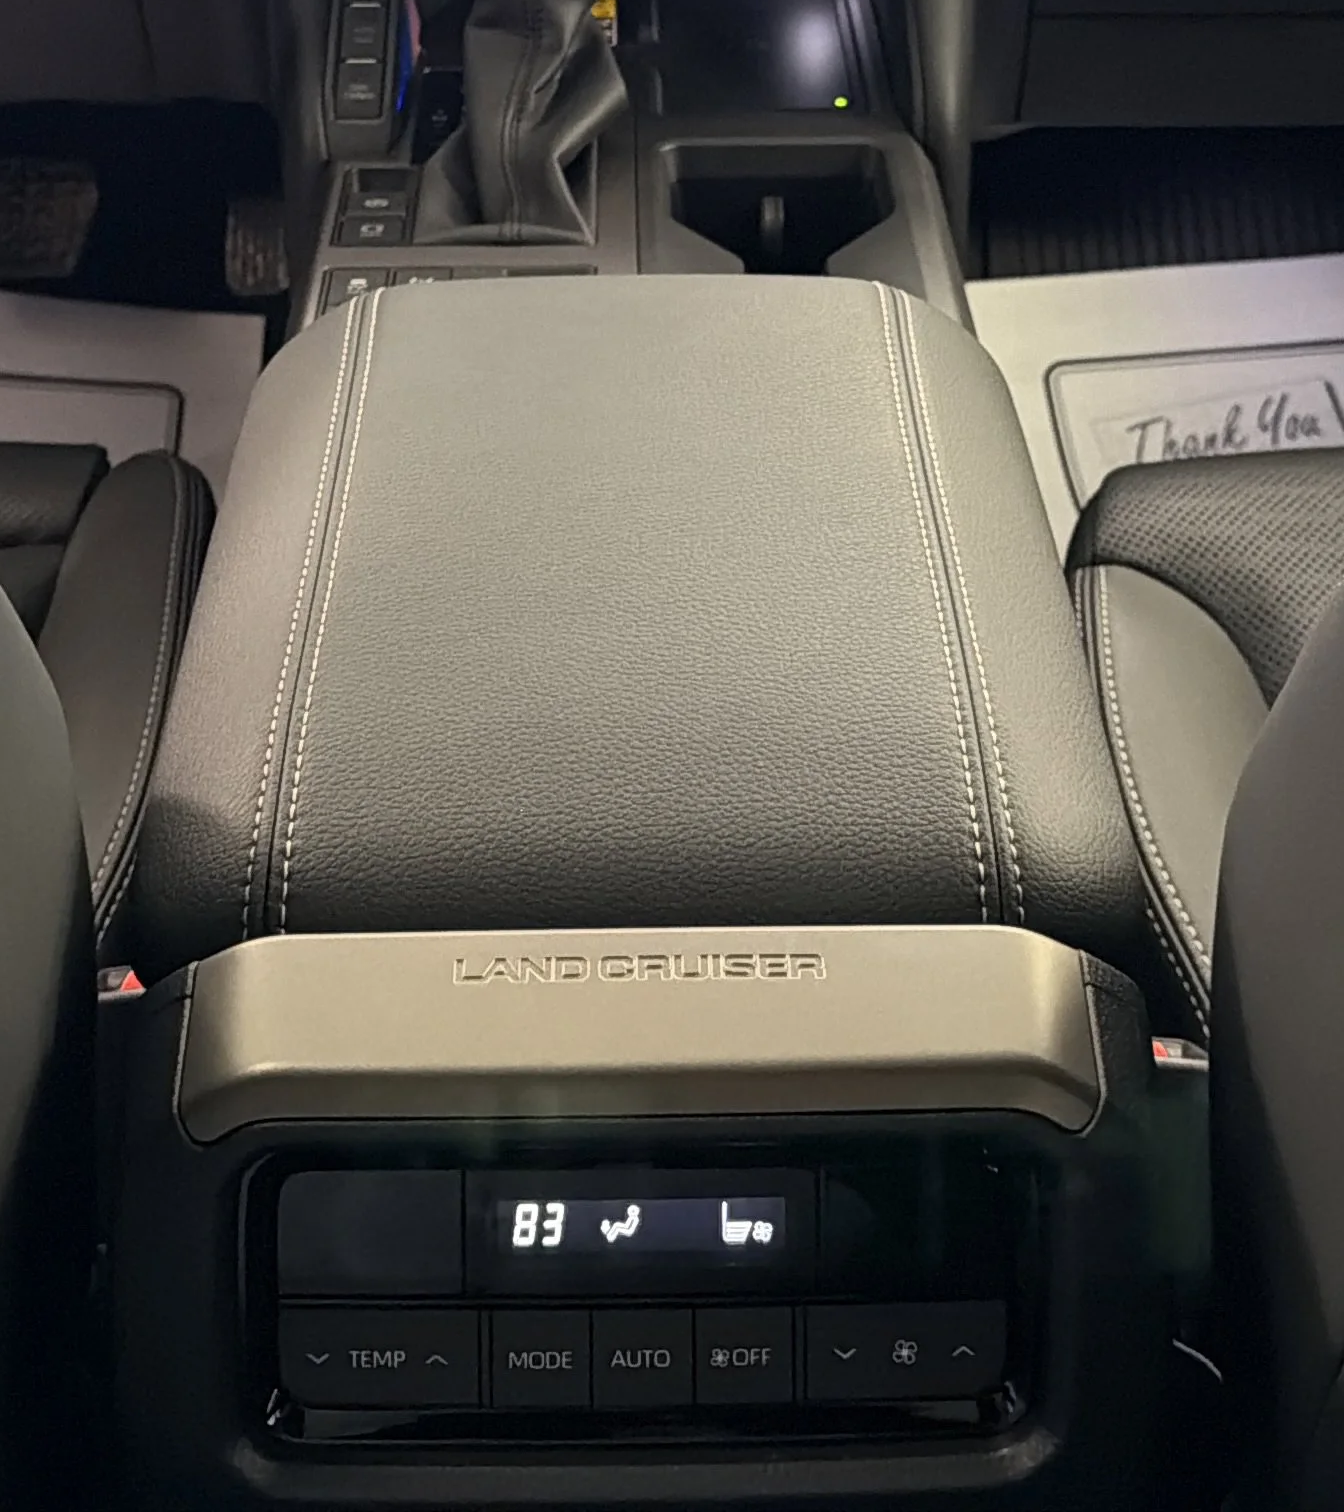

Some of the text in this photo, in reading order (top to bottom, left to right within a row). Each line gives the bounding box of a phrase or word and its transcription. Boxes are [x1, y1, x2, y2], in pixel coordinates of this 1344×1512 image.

[1126, 392, 1322, 464] Thank You
[452, 952, 828, 985] LAND CRUISER
[512, 1202, 565, 1247] 83
[349, 1349, 406, 1370] TEMP
[508, 1350, 573, 1370] MODE
[610, 1349, 671, 1368] AUTO
[732, 1347, 772, 1367] OFF
